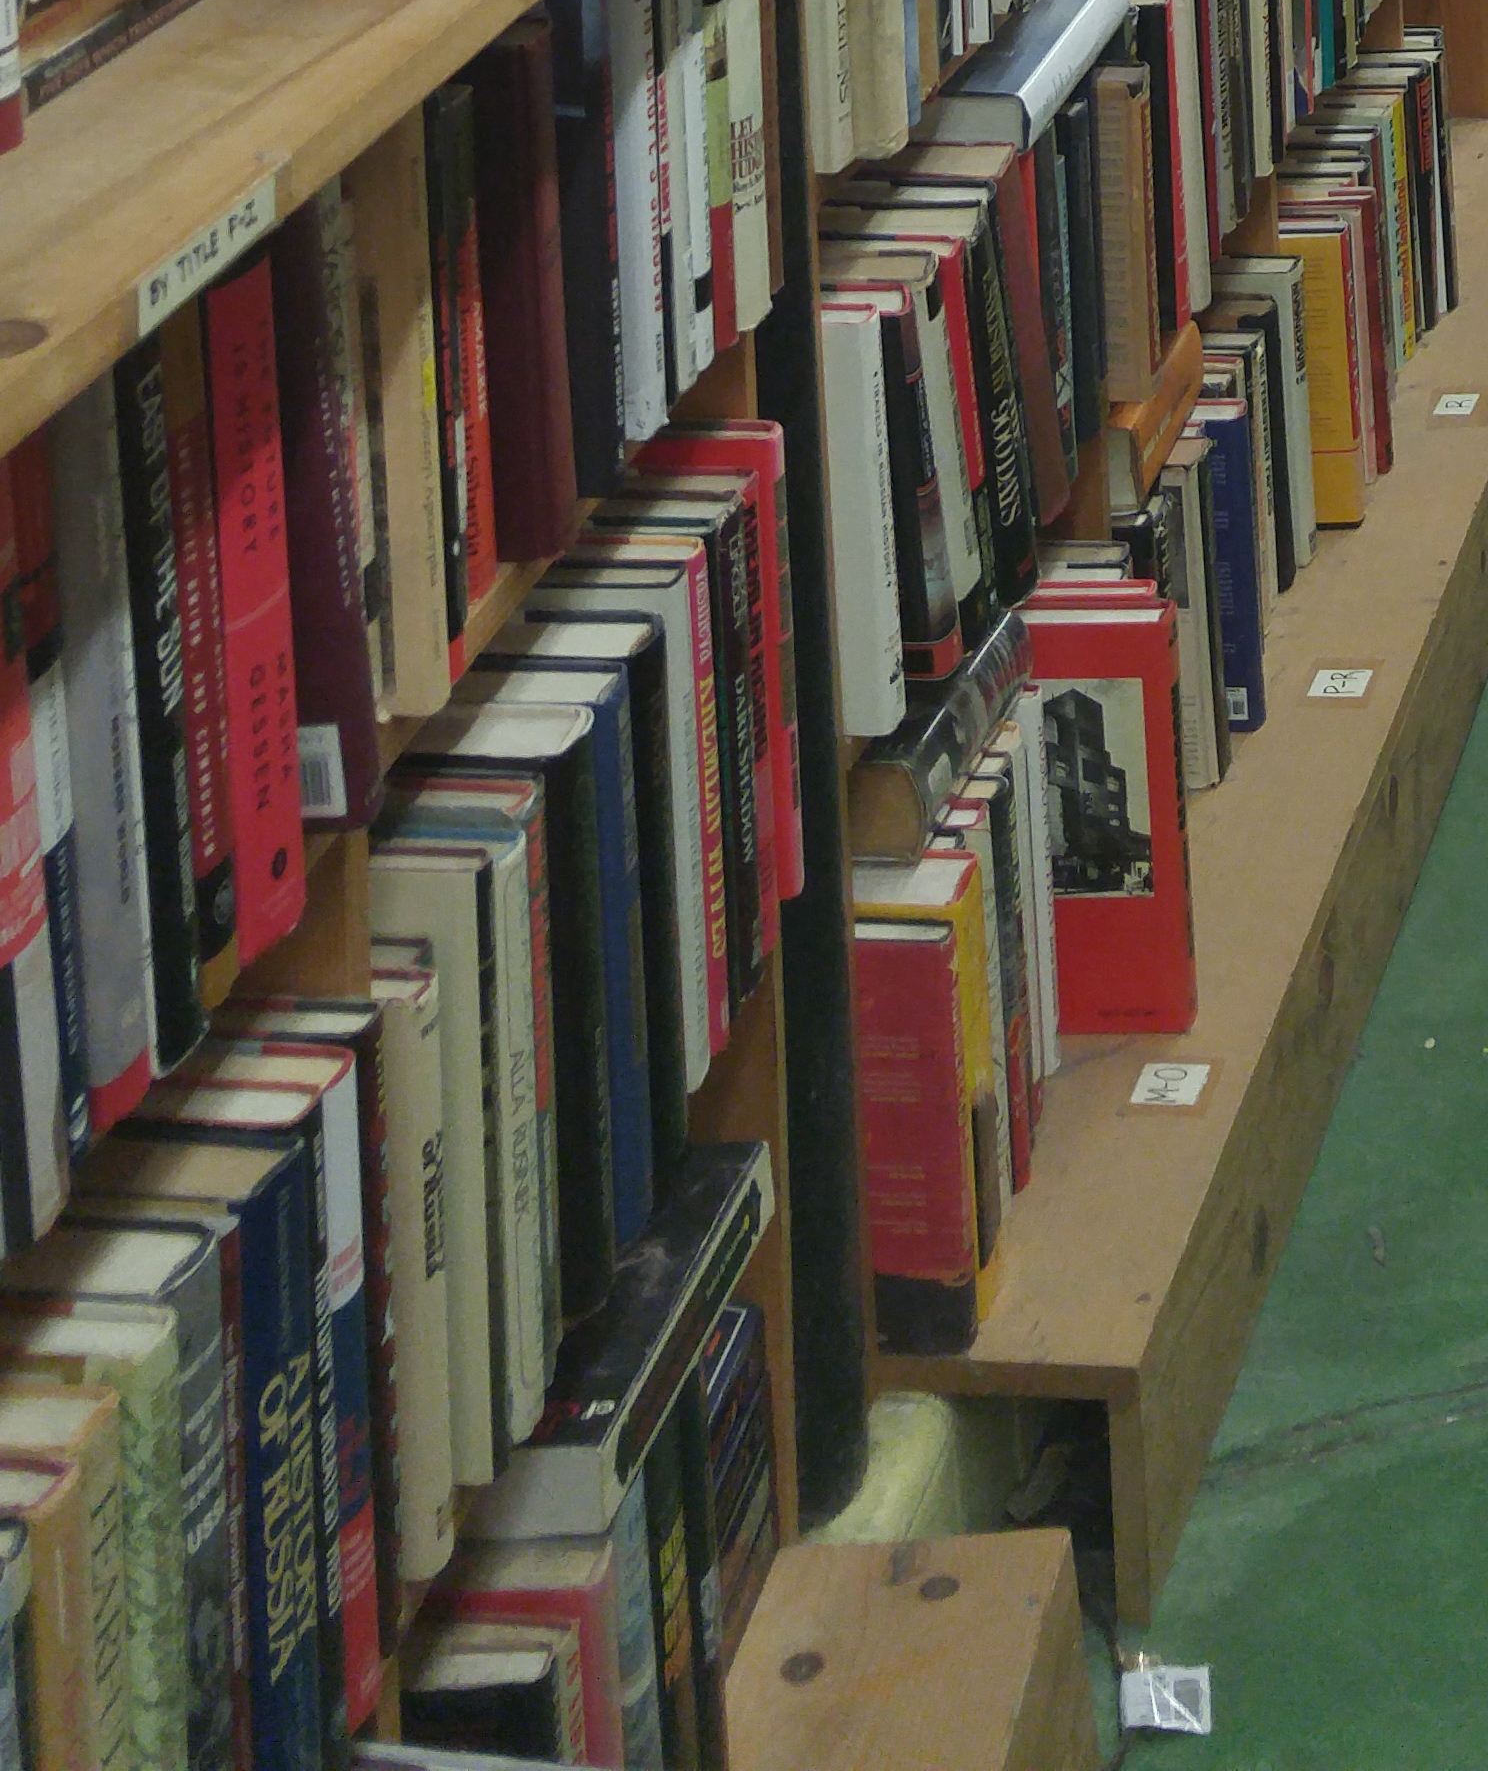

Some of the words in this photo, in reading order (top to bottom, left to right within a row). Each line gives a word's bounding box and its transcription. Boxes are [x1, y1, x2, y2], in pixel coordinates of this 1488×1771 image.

[175, 230, 220, 281] TITLE
[138, 378, 166, 461] EAST
[148, 466, 172, 523] OF
[153, 543, 179, 616] THE
[154, 622, 187, 718] SUN
[698, 674, 722, 836] KREMLIN
[705, 845, 729, 960] WIVES
[1150, 1064, 1188, 1106] M-O
[257, 1374, 289, 1449] OF
[289, 1399, 318, 1641] HISTORY
[261, 1458, 297, 1688] RUSSIA
